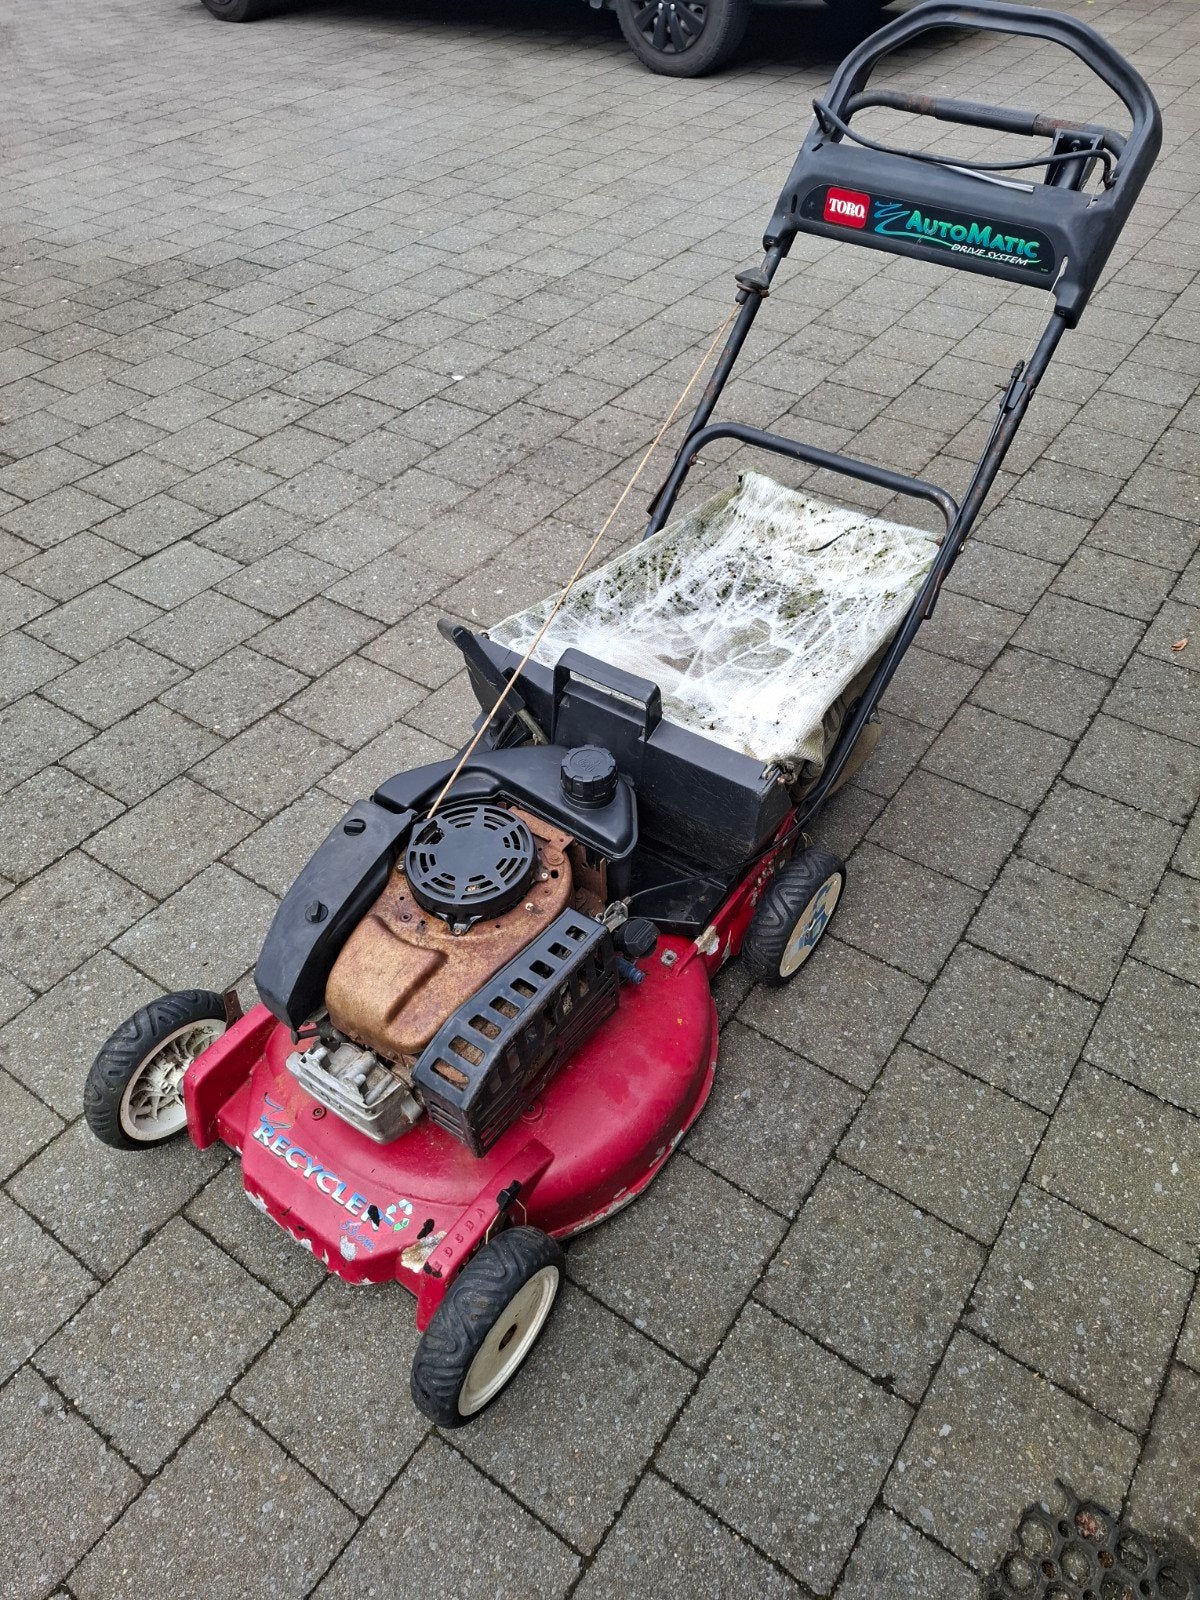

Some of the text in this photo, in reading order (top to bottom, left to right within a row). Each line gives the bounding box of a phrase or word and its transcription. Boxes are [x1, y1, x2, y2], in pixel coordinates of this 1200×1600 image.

[829, 198, 865, 219] TORO
[951, 243, 1029, 266] DRIVE SYSTEM
